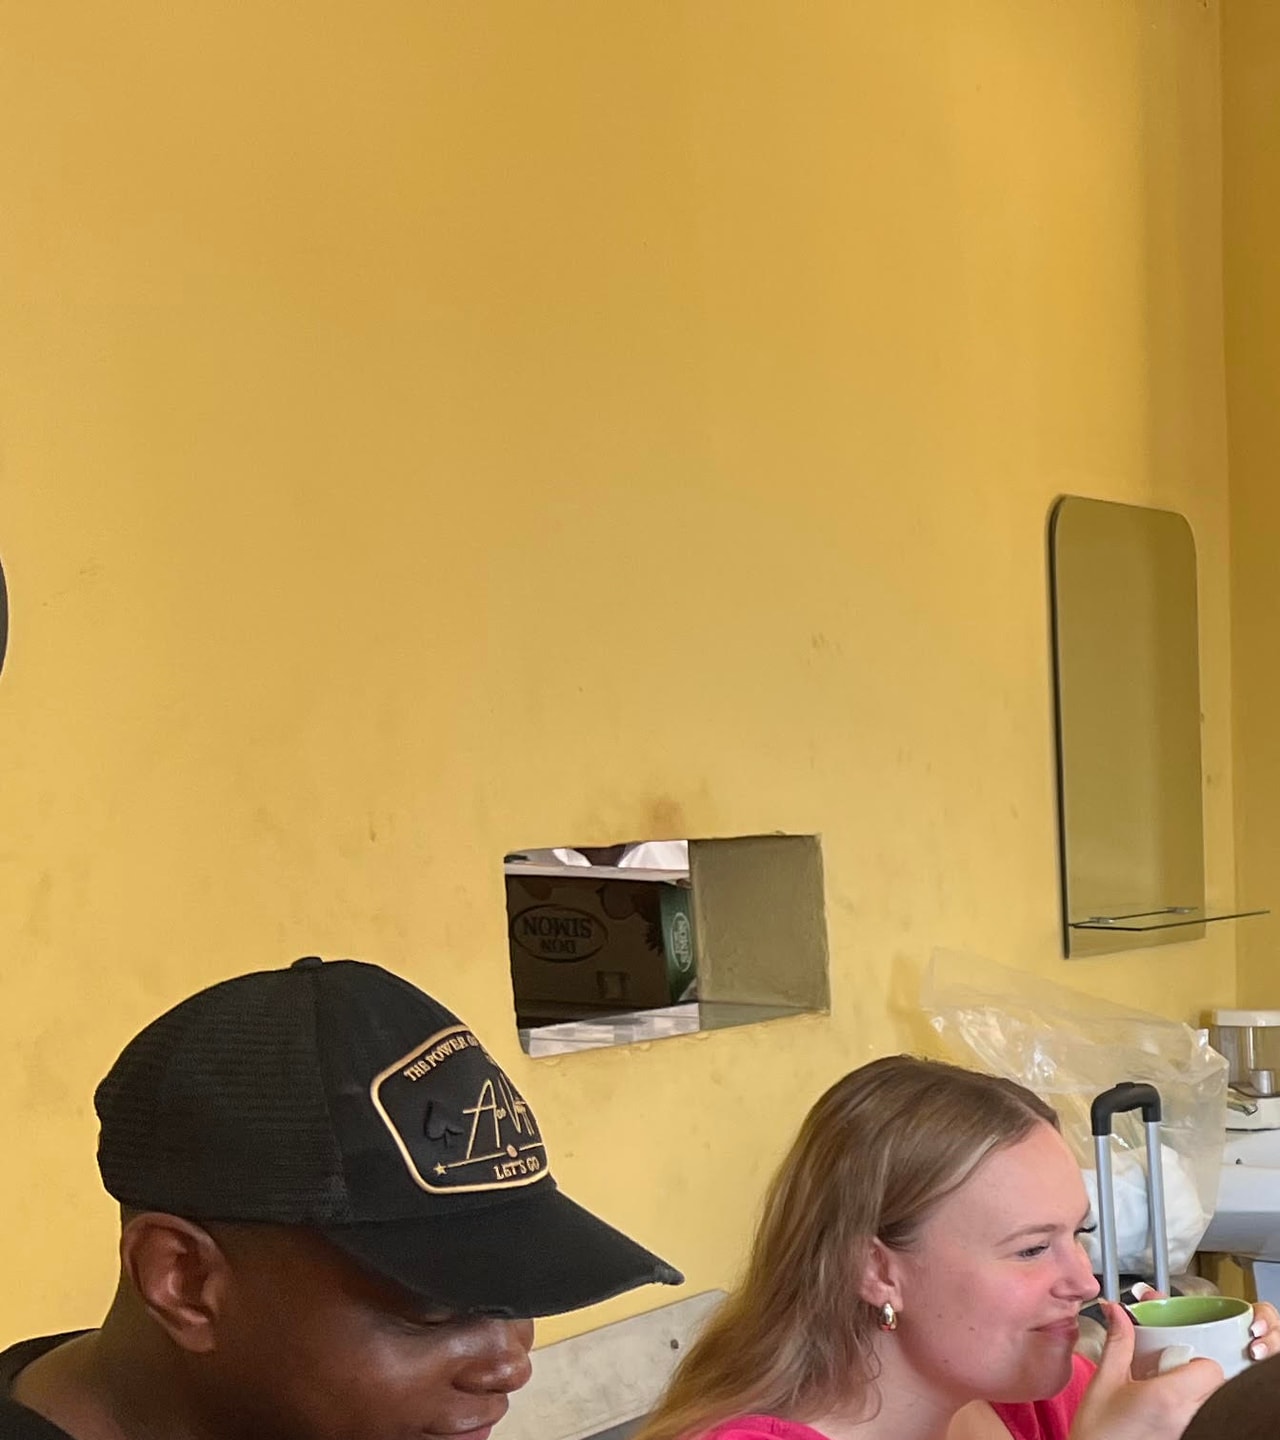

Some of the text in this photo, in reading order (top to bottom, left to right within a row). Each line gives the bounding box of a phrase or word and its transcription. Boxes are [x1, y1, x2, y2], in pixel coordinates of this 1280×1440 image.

[523, 915, 592, 939] SIMON
[402, 1033, 480, 1082] THE POWER O
[493, 1155, 541, 1180] LET'S GO
